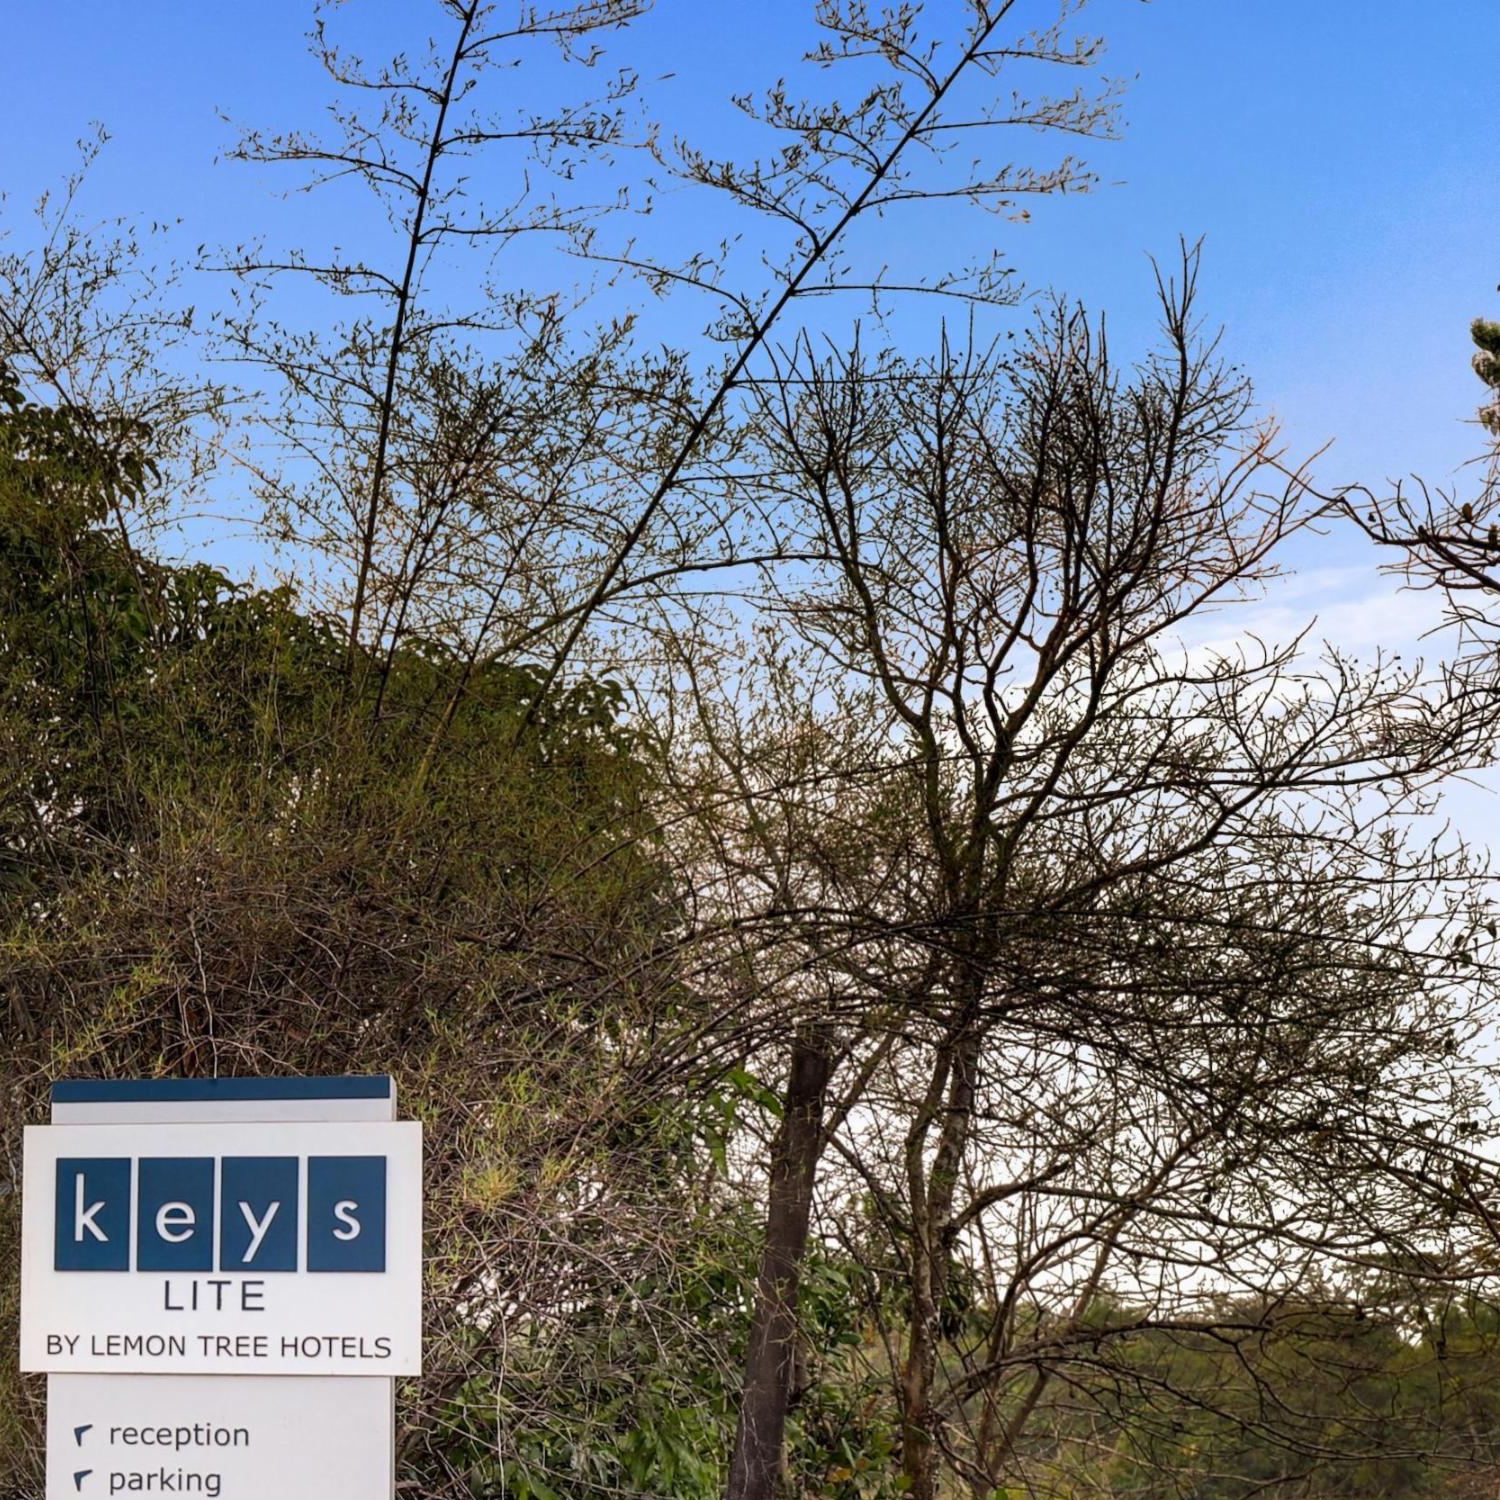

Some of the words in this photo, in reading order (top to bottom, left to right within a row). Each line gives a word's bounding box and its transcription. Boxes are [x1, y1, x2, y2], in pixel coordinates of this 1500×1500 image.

[74, 1173, 362, 1263] keys
[164, 1280, 265, 1311] LITE
[46, 1335, 80, 1355] BY
[91, 1335, 185, 1356] LEMON
[197, 1336, 268, 1357] TREE
[281, 1338, 391, 1358] HOTELS
[109, 1423, 250, 1451] reception
[109, 1468, 221, 1497] parking
